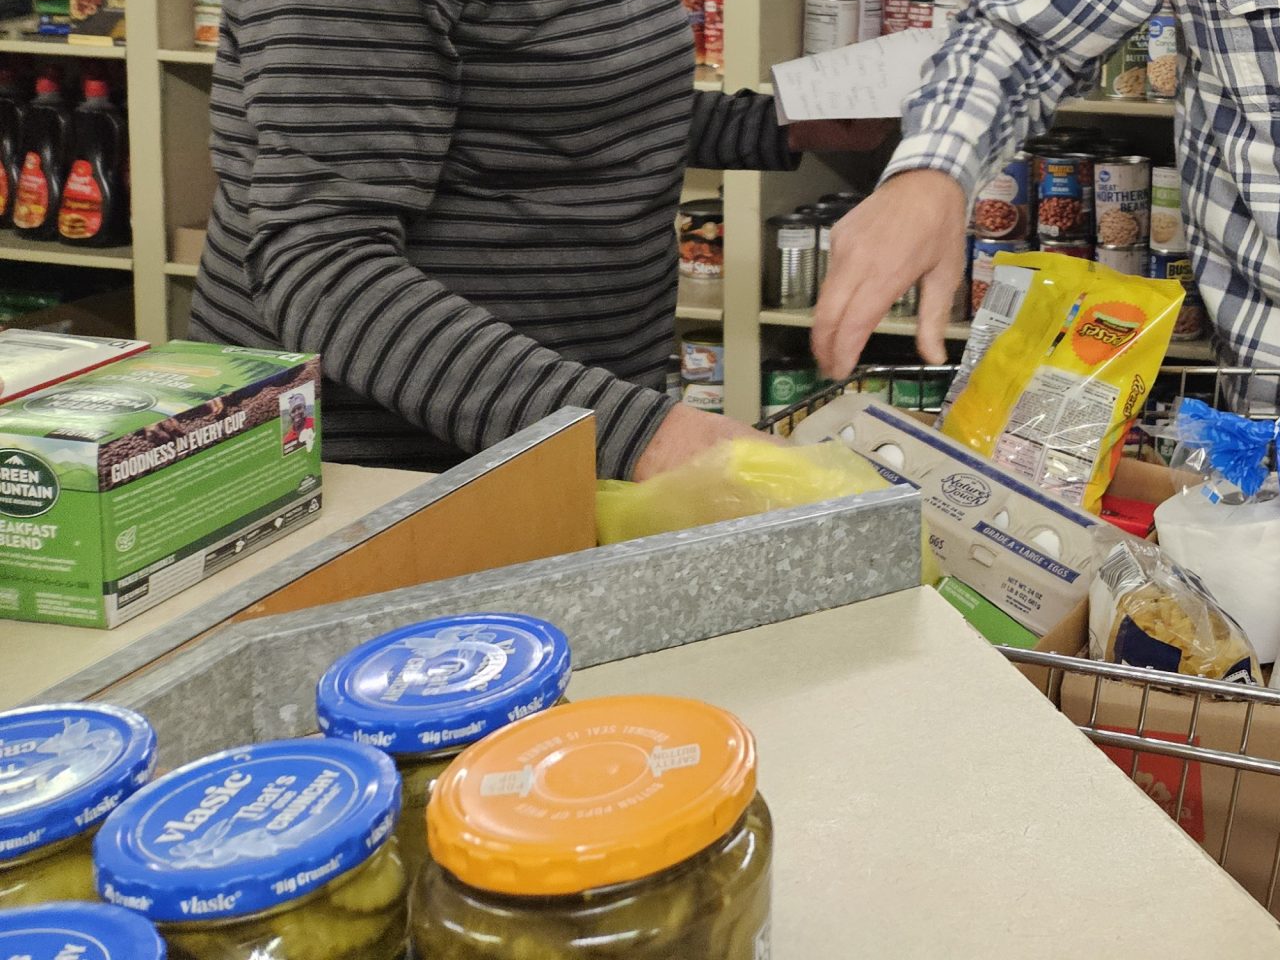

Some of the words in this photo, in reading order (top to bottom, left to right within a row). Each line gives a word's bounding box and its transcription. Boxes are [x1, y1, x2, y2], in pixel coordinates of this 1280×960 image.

[1097, 191, 1149, 203] NORTHERN
[112, 441, 177, 484] GOODNESS
[176, 437, 191, 457] IN
[189, 423, 224, 450] EVERY
[224, 410, 248, 434] CUP
[941, 474, 992, 500] Nature's
[945, 486, 984, 506] Touch
[982, 526, 1011, 546] GRADE
[1018, 544, 1045, 564] LARGE
[1047, 562, 1070, 579] EGGS
[585, 725, 617, 737] SEAL
